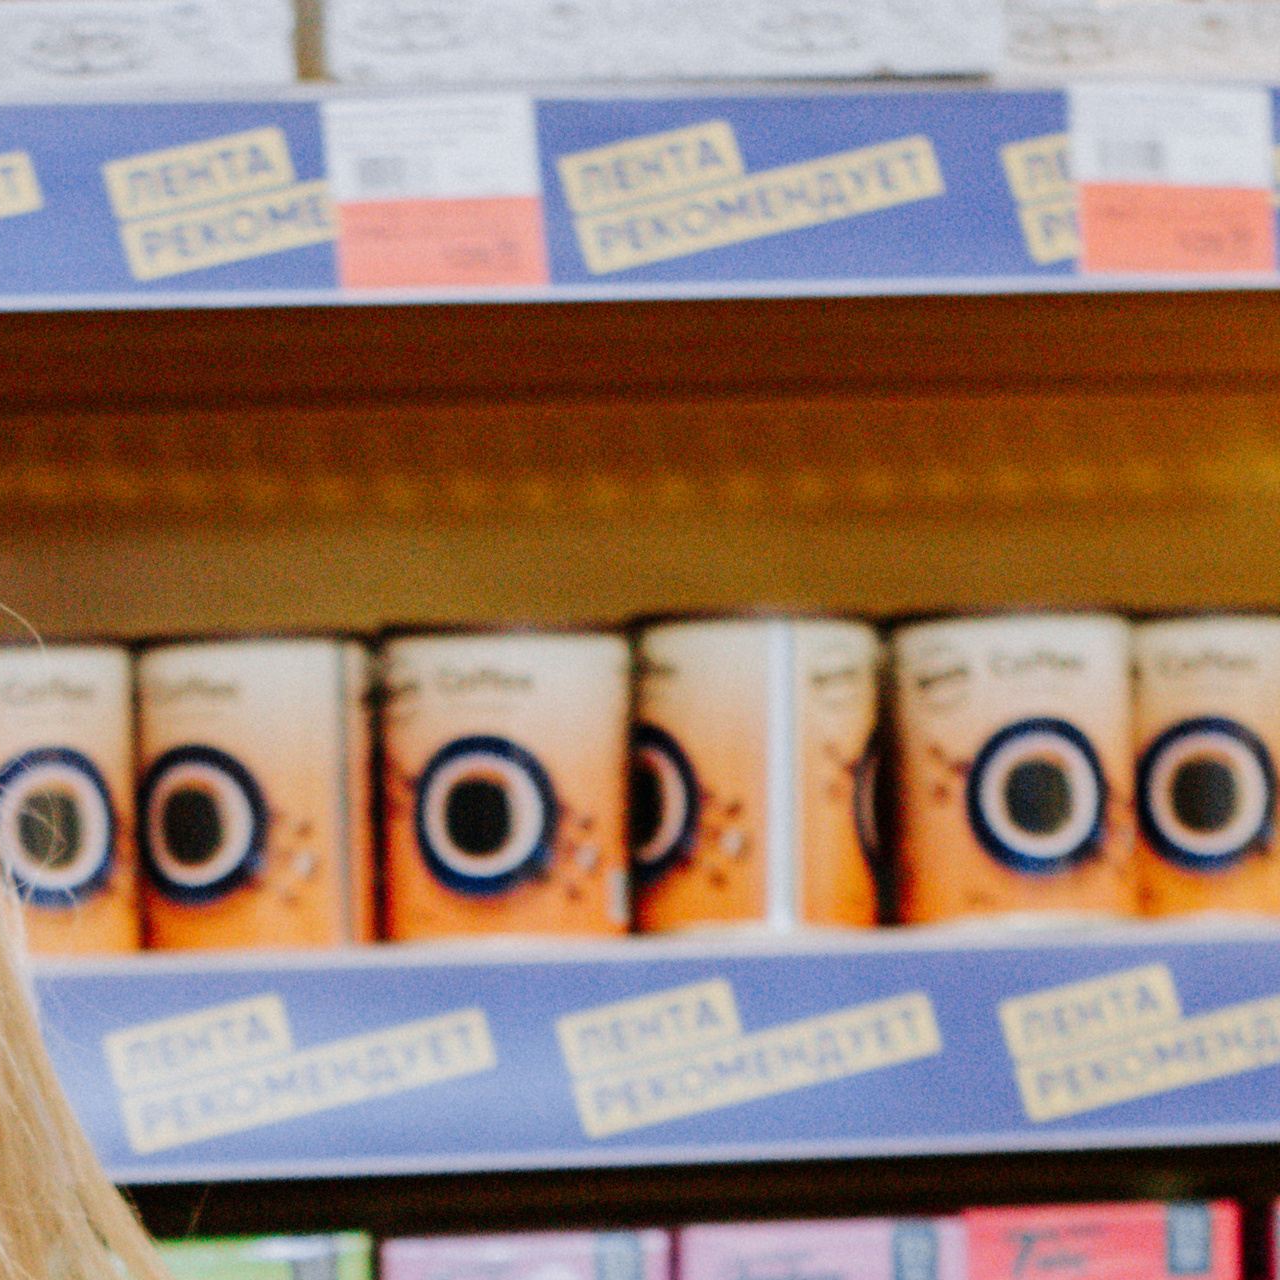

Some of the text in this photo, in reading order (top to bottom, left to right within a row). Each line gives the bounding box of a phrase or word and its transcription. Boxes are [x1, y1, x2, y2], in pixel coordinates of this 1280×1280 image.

[125, 143, 275, 206] ЛЕНТА
[578, 138, 724, 199] ЛЕНТА
[594, 150, 919, 258] РЕКОМЕНДУЕТ
[125, 1013, 274, 1074] ЛЕНТА
[578, 999, 723, 1060] ЛЕНТА
[1023, 983, 1160, 1043] ЛЕНТА
[139, 1024, 473, 1136] РЕКОМЕНДУЕТ
[592, 1008, 919, 1121] РЕКОМЕНДУЕТ
